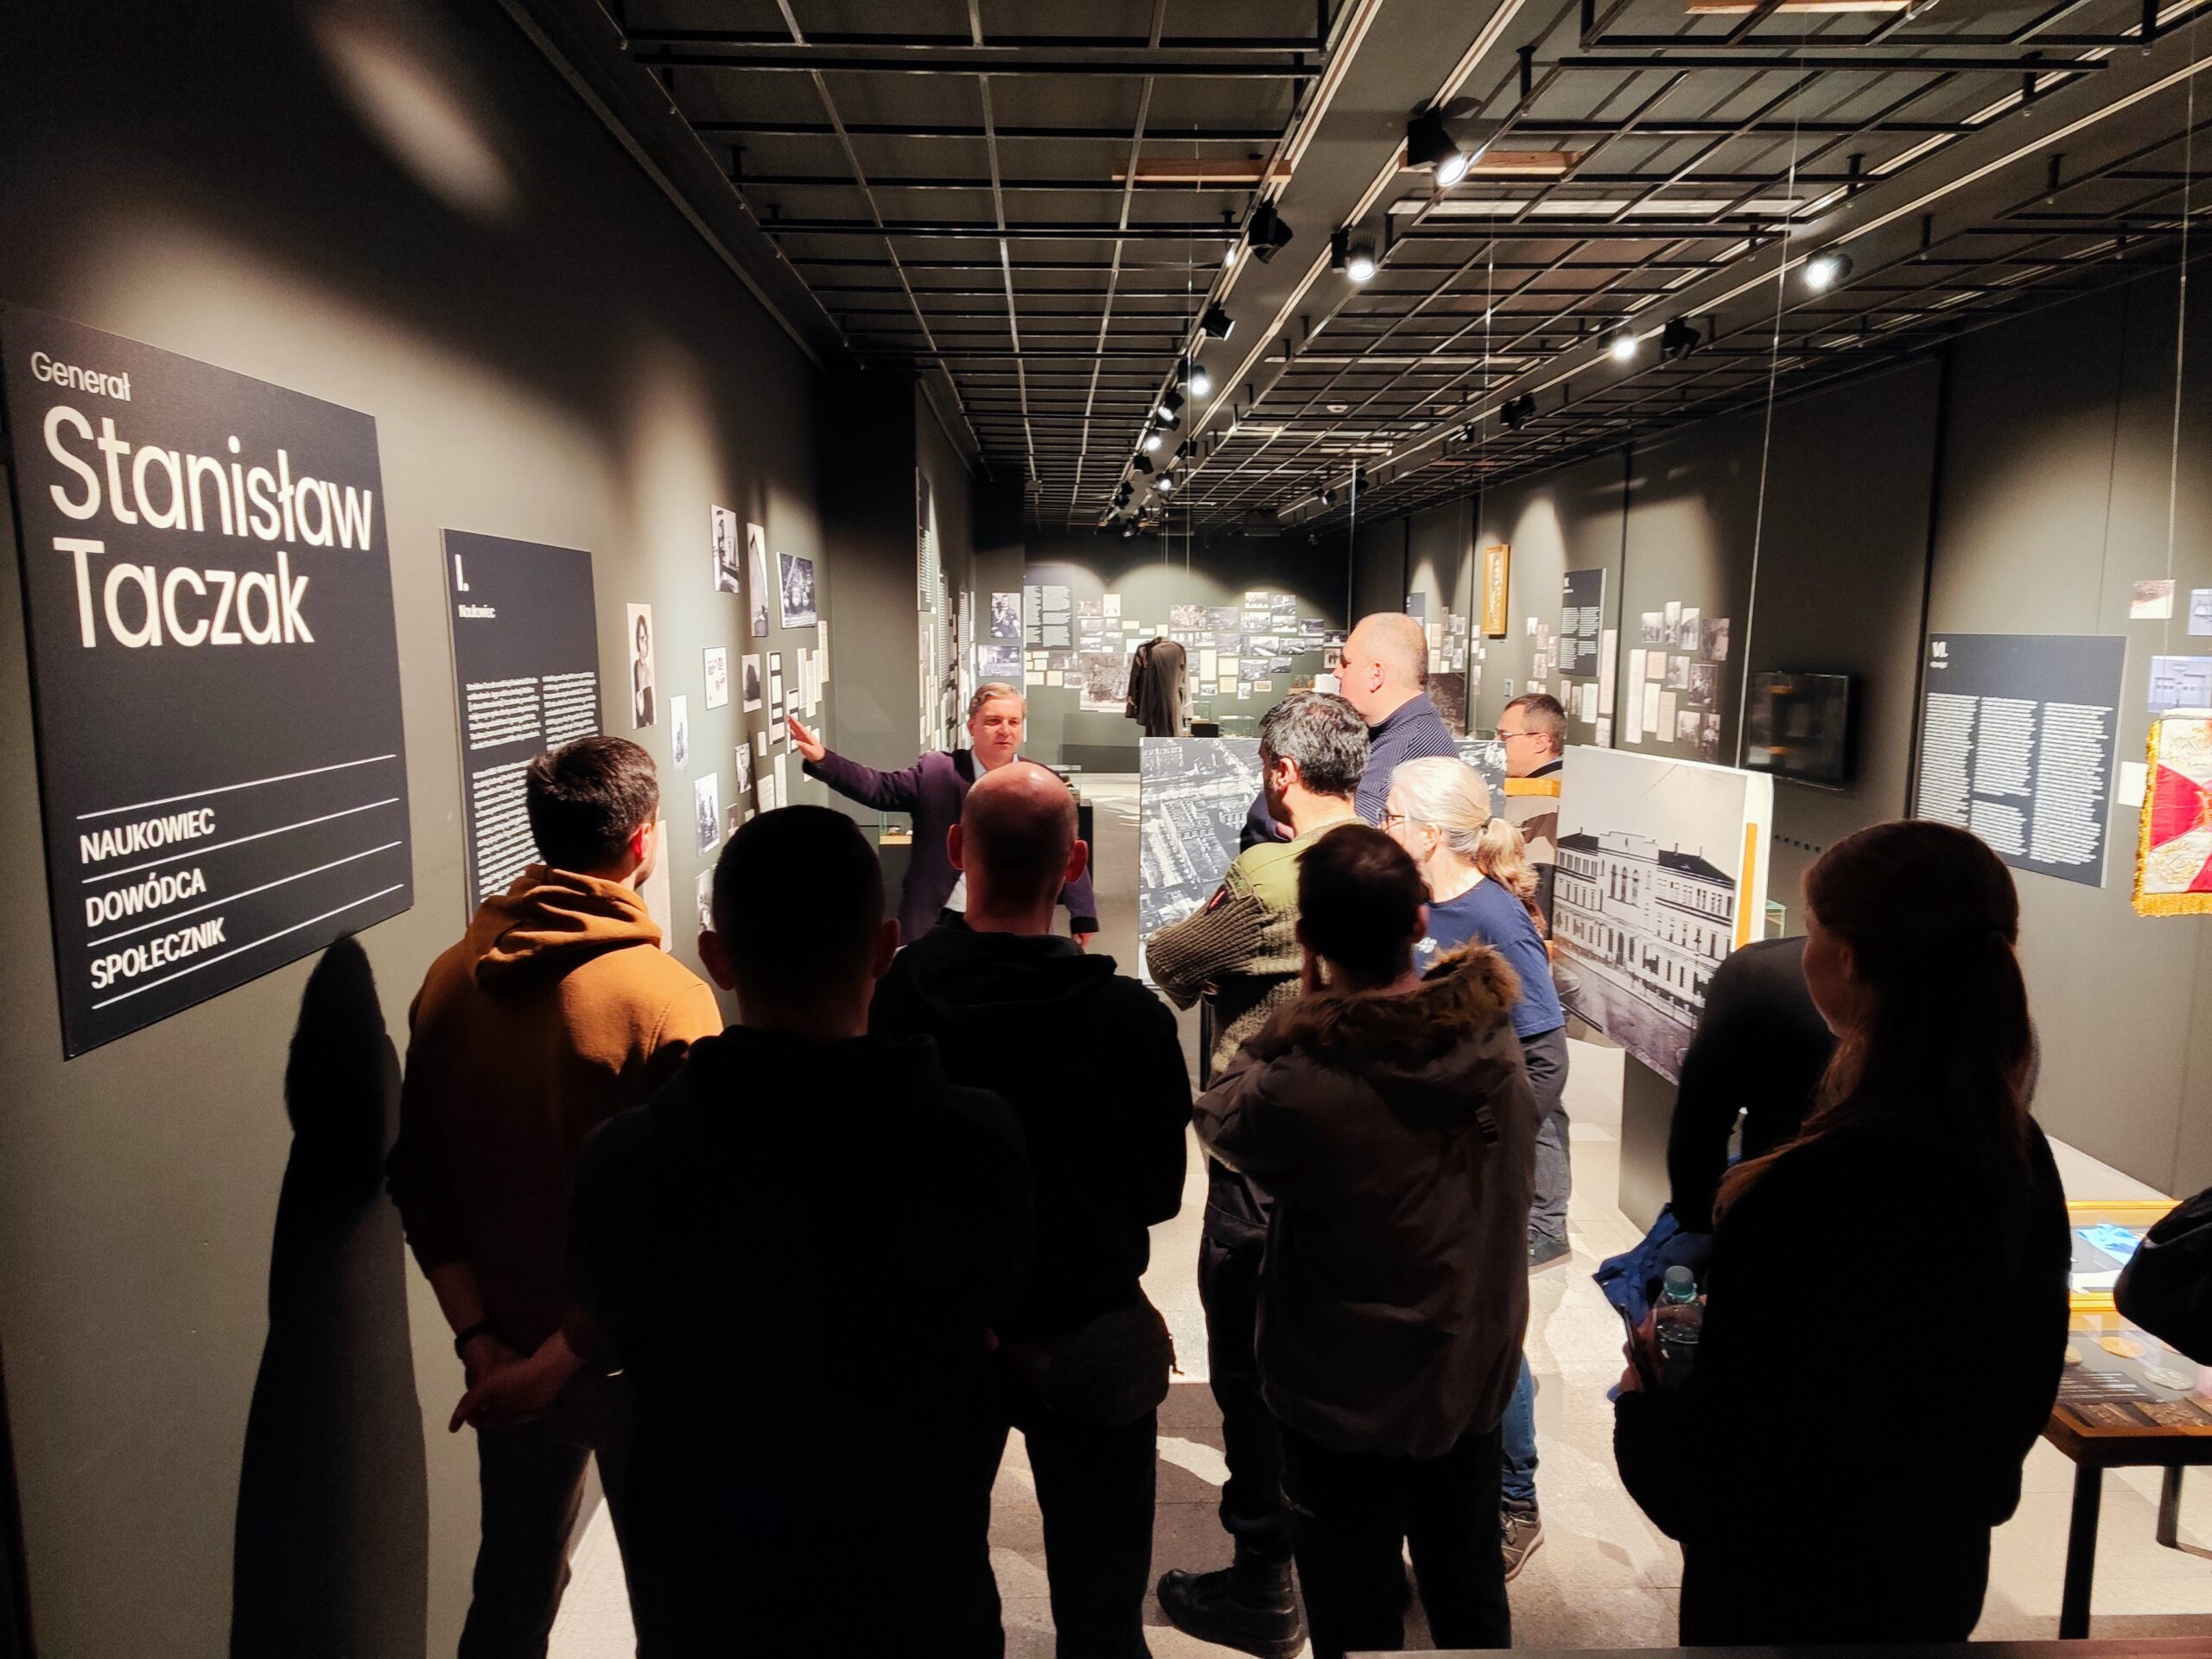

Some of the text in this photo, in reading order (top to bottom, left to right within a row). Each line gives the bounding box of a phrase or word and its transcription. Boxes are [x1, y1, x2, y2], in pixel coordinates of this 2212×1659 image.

[31, 352, 131, 402] Generał
[44, 405, 373, 551] Stanisław
[53, 537, 315, 648] Taczak
[79, 807, 216, 864] NAUKOWIEC
[85, 868, 207, 927] DOWÓDCA
[90, 917, 226, 989] SPOŁECZNIK
